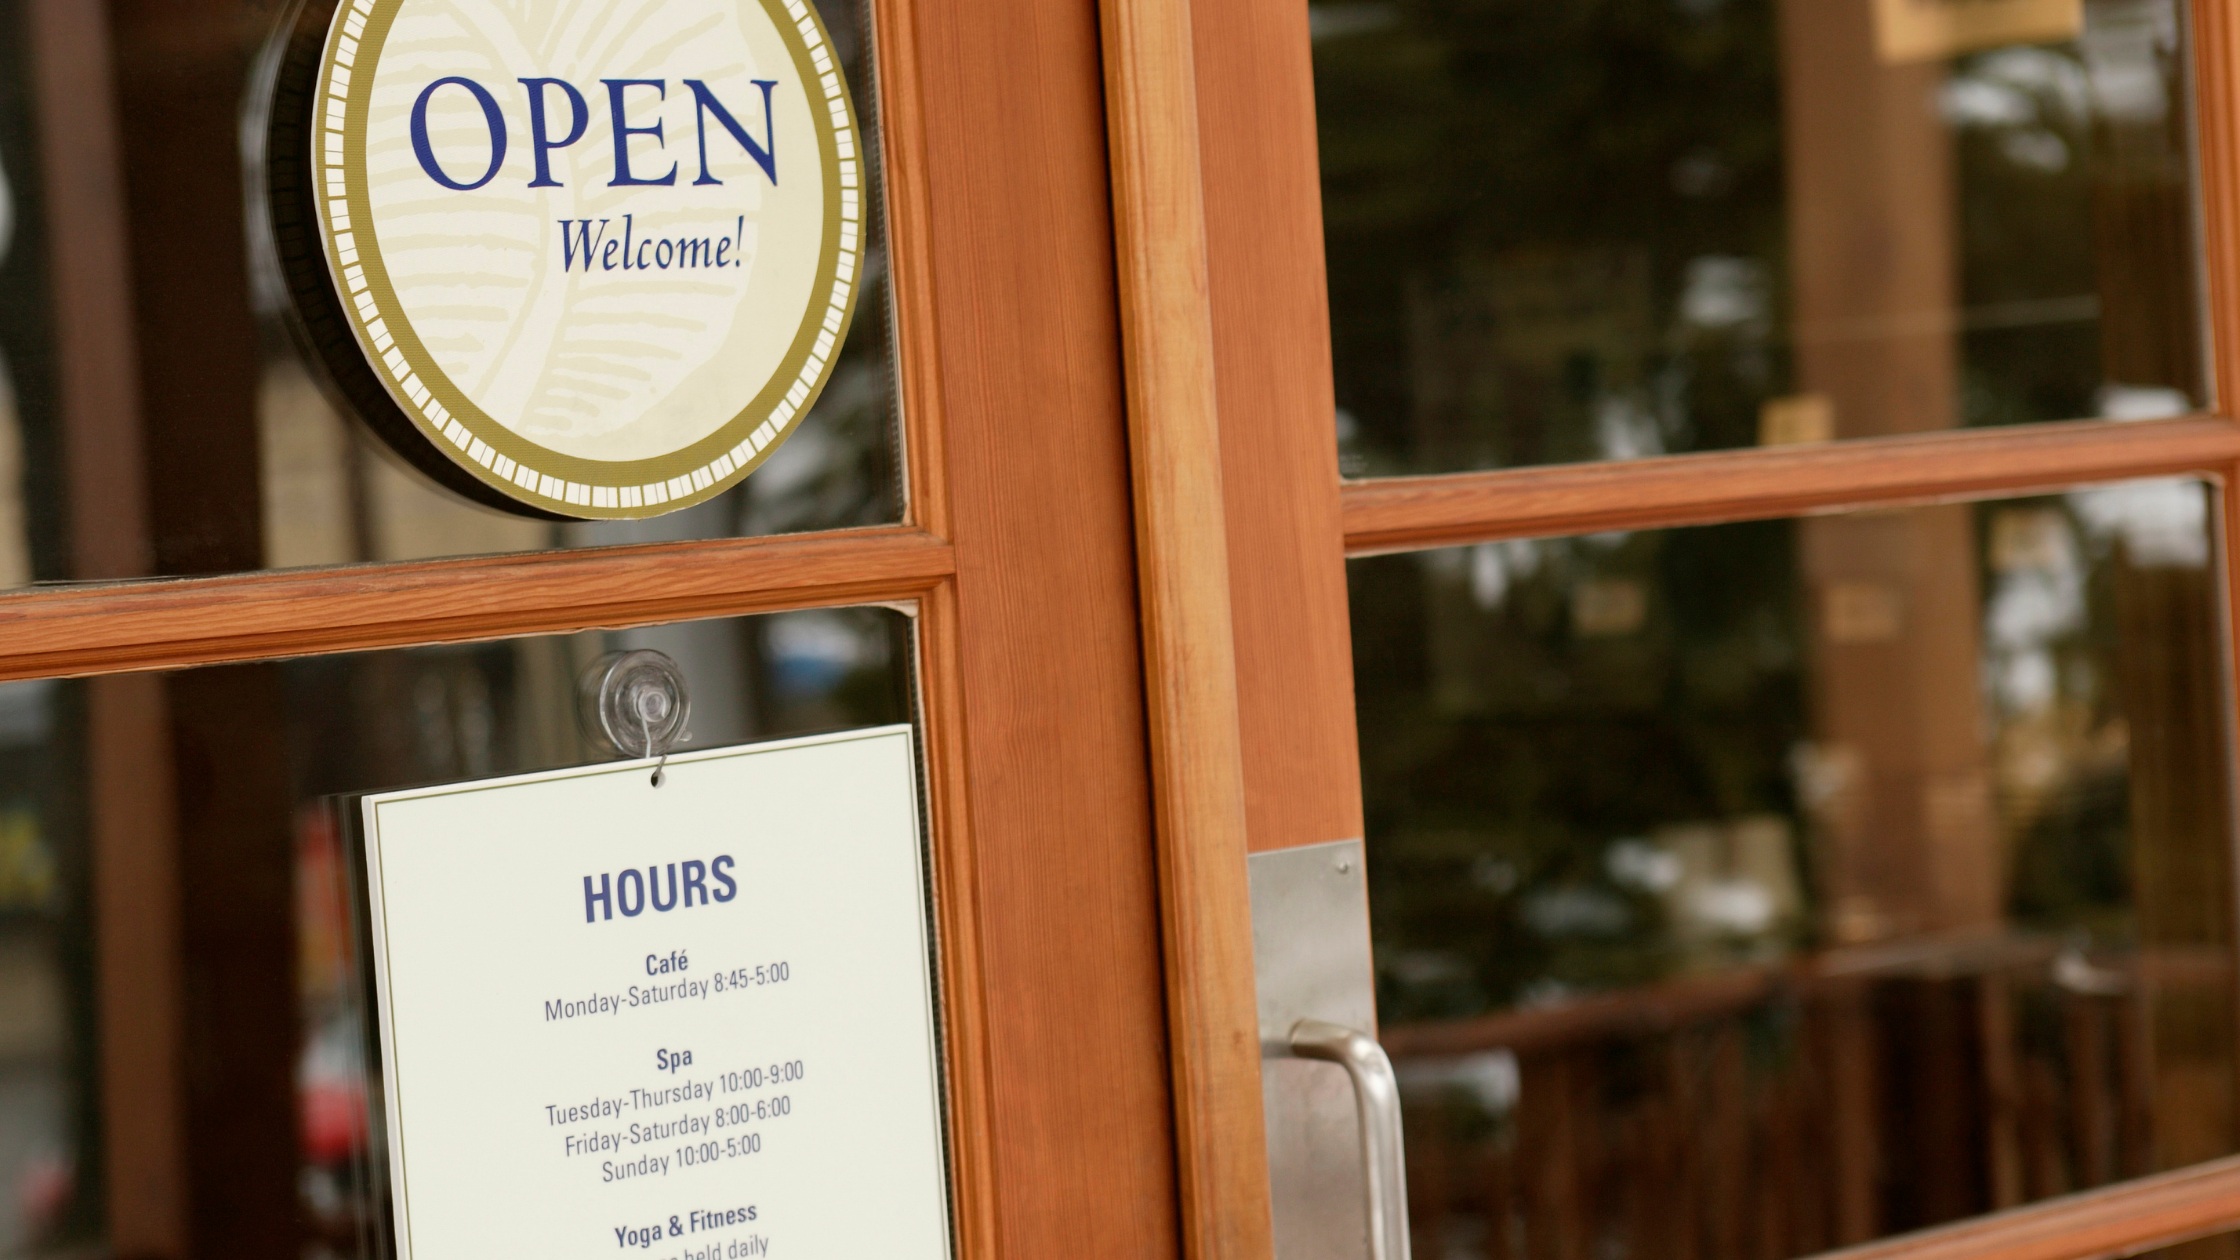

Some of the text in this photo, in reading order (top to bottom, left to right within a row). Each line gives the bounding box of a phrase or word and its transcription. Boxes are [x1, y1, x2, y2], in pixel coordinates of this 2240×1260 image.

[409, 75, 779, 192] OPEN
[557, 213, 745, 273] Welcome!
[583, 854, 738, 924] HOURS
[545, 961, 790, 1022] Monday-Saturday 8:45-5:00
[645, 950, 689, 977] Café
[656, 1048, 693, 1075] Spa
[545, 1060, 804, 1127] Tuesday-Thursday 10:00-9:00
[565, 1095, 791, 1157] Friday-Saturday 8:00-6:00
[602, 1132, 761, 1182] Sunday 10:00-5:00
[614, 1205, 758, 1249] Yoga & Fitness
[728, 1234, 769, 1260] daily
